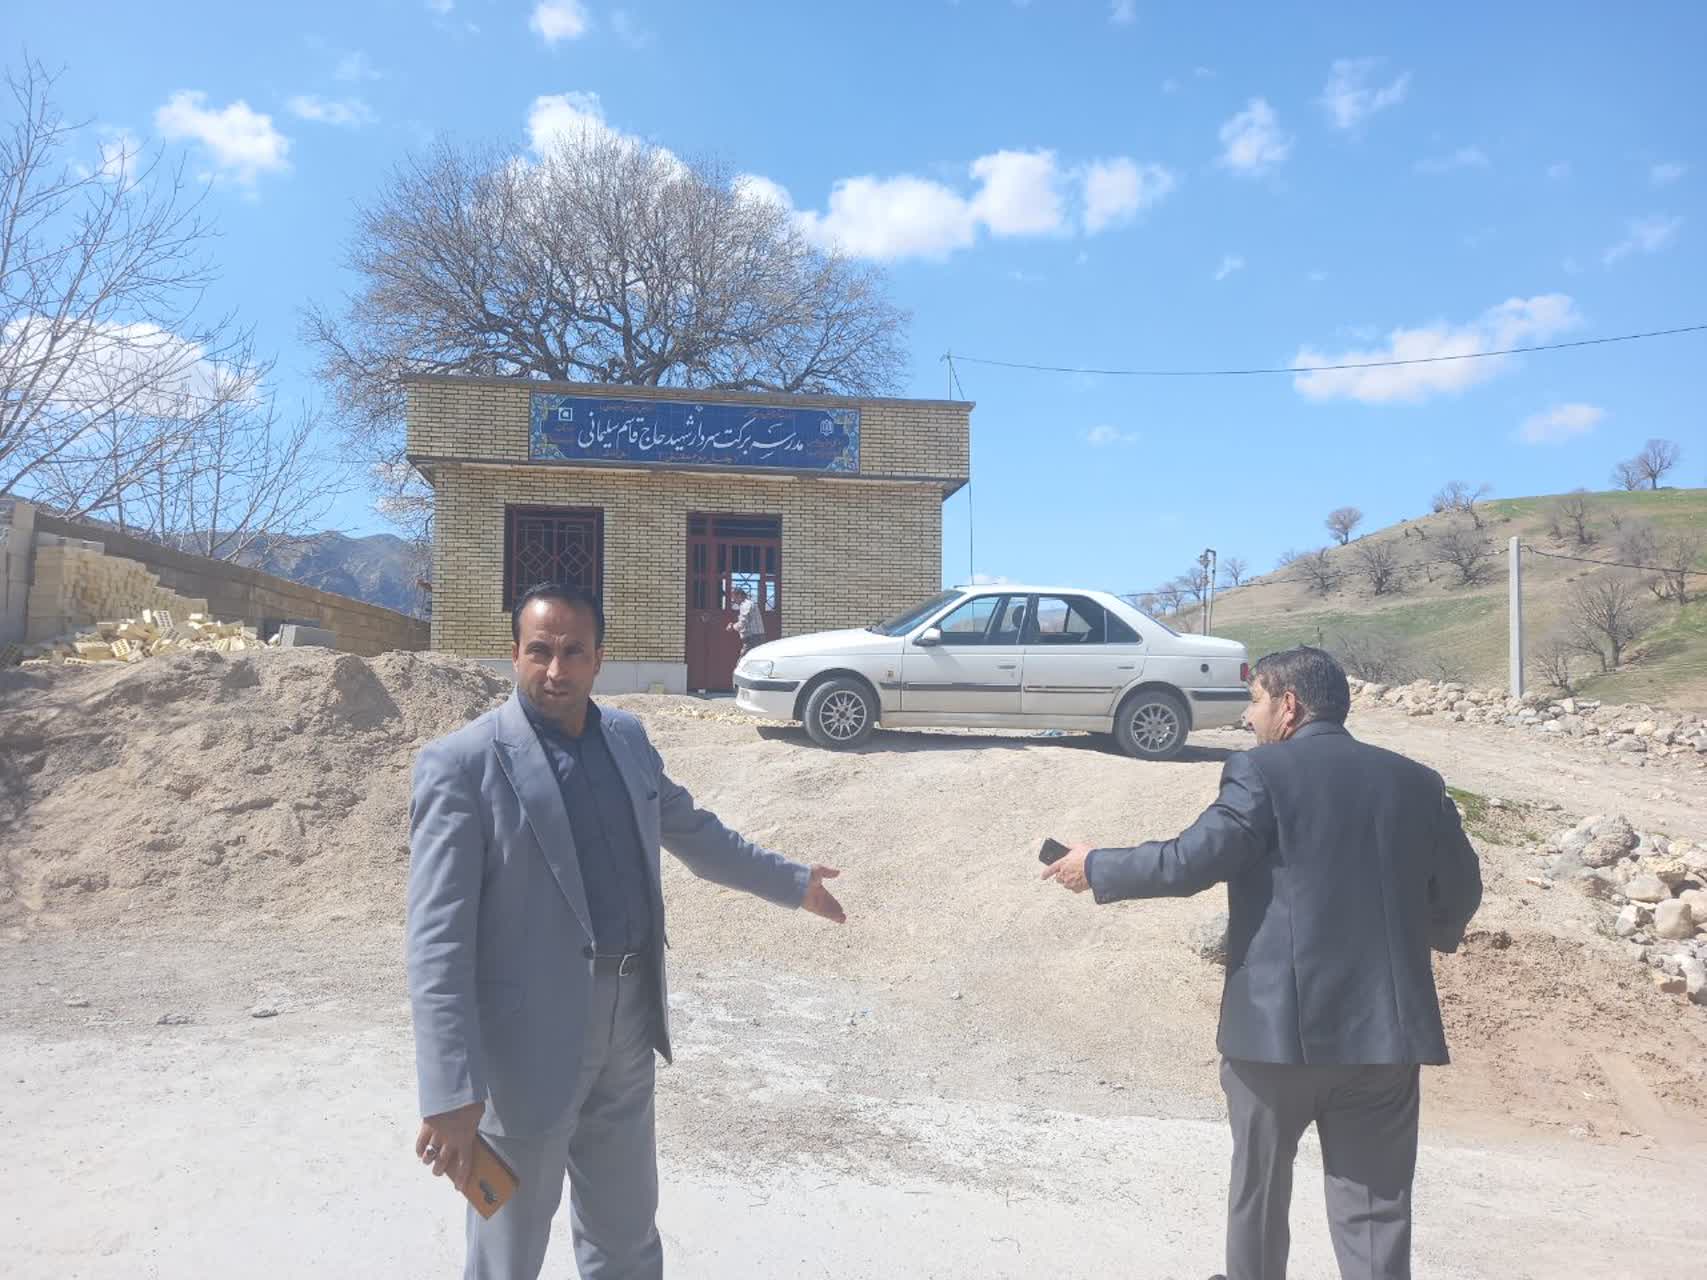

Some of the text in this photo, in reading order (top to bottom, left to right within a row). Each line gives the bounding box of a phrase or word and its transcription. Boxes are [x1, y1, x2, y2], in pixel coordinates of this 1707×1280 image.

[577, 411, 620, 449] سلیمانی
[616, 416, 645, 449] قاسم
[639, 420, 666, 451] حاج
[664, 414, 694, 451] شهید
[688, 420, 721, 452] سردار
[713, 417, 756, 455] برکت
